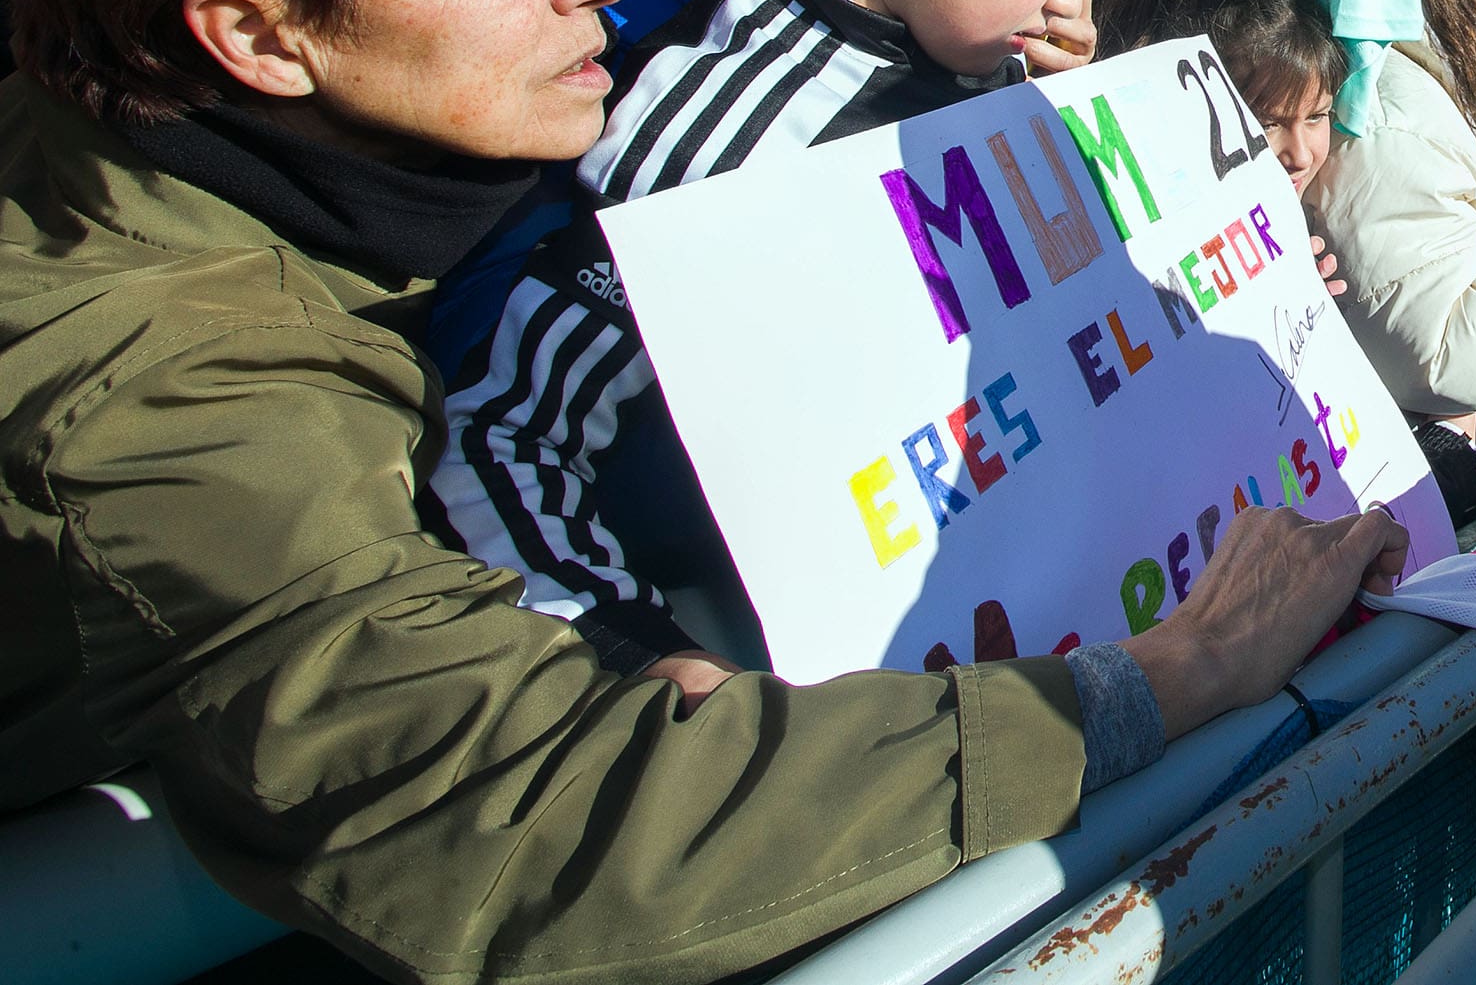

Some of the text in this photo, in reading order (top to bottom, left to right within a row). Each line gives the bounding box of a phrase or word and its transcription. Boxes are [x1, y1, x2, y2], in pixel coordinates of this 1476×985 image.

[1176, 50, 1268, 181] 22
[576, 268, 632, 313] adid
[846, 372, 1043, 570] ERES
[1067, 308, 1154, 408] EL
[1151, 202, 1283, 341] MEJOR
